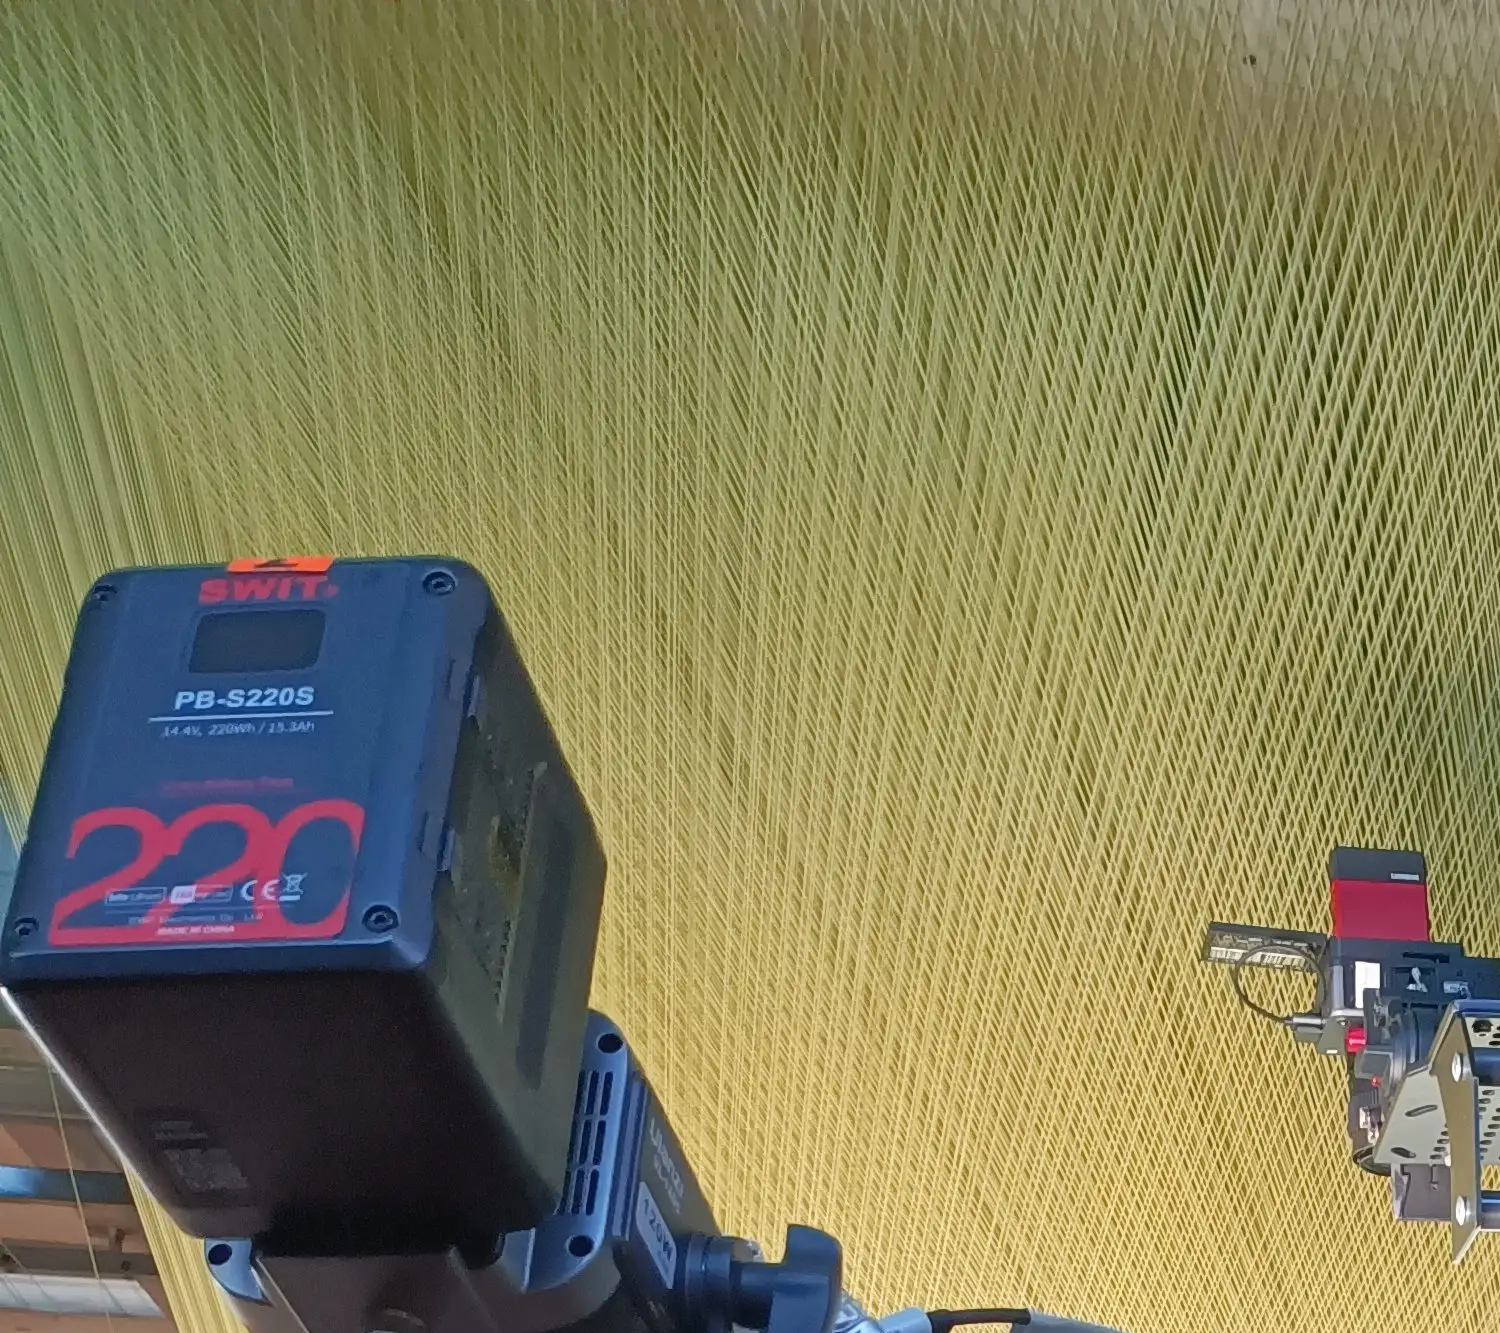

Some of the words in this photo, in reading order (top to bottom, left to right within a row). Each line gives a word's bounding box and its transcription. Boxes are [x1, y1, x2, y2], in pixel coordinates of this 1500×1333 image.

[199, 576, 328, 605] SWIT
[174, 686, 315, 710] PB-S220S
[48, 798, 366, 946] 220
